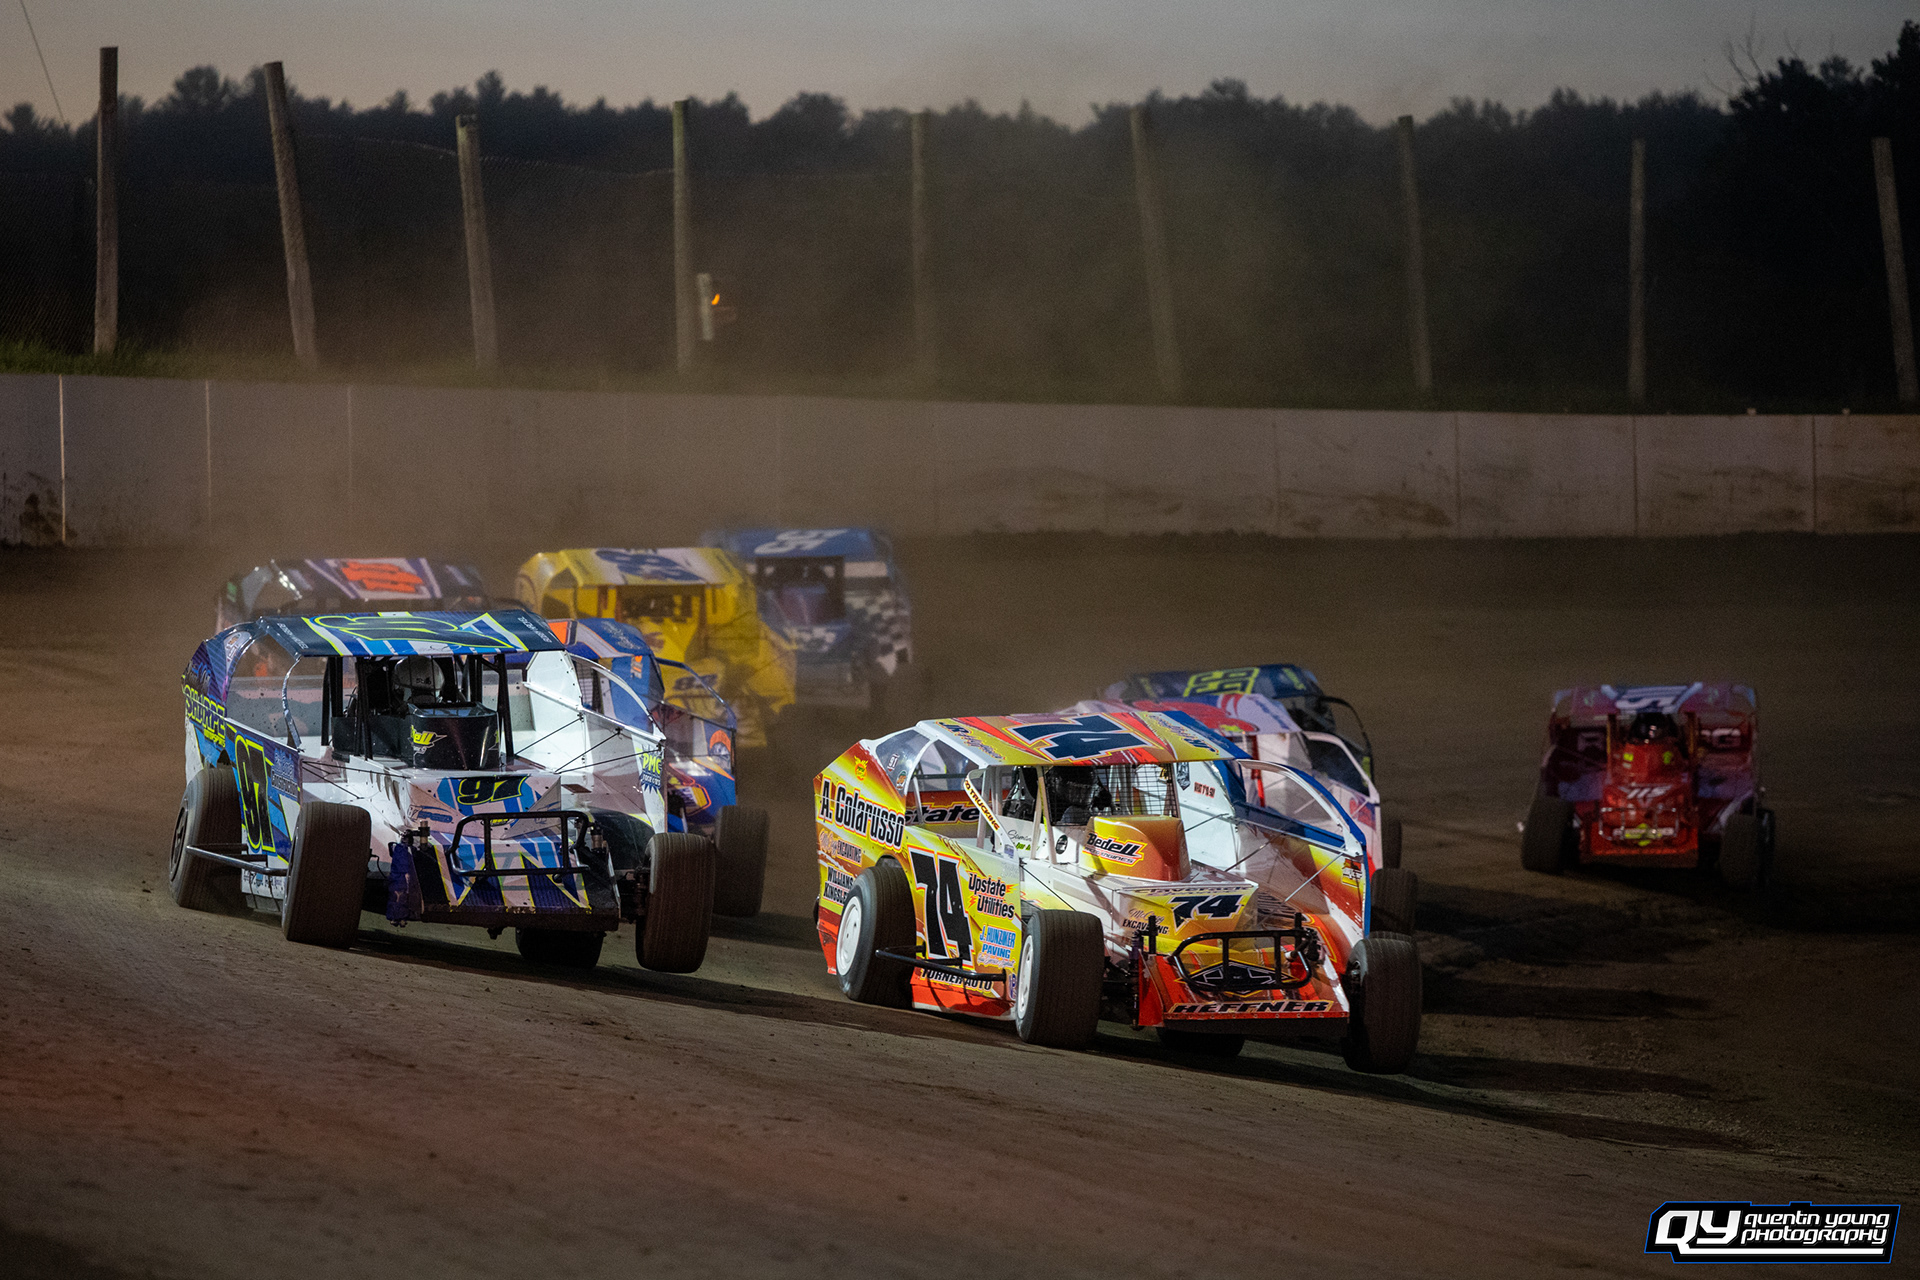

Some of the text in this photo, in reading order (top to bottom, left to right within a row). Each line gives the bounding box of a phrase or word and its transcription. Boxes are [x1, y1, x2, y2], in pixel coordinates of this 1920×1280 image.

[1011, 713, 1149, 760] 74
[642, 752, 662, 775] PMC
[235, 734, 276, 853] 97
[456, 774, 530, 806] 97
[820, 779, 905, 848] A. Colarusso
[905, 805, 980, 823] state
[1087, 832, 1142, 857] Bedell
[823, 881, 850, 905] KINGSLE
[968, 873, 1007, 897] Upstate
[910, 851, 973, 963] 74
[977, 895, 1015, 919] Utilities
[1129, 908, 1166, 925] McCgg
[1170, 894, 1244, 929] 74
[1122, 918, 1169, 935] EXCAVNG
[982, 943, 1011, 959] PAVING
[964, 976, 992, 991] AUTO
[1173, 1000, 1331, 1013] HEFFNER
